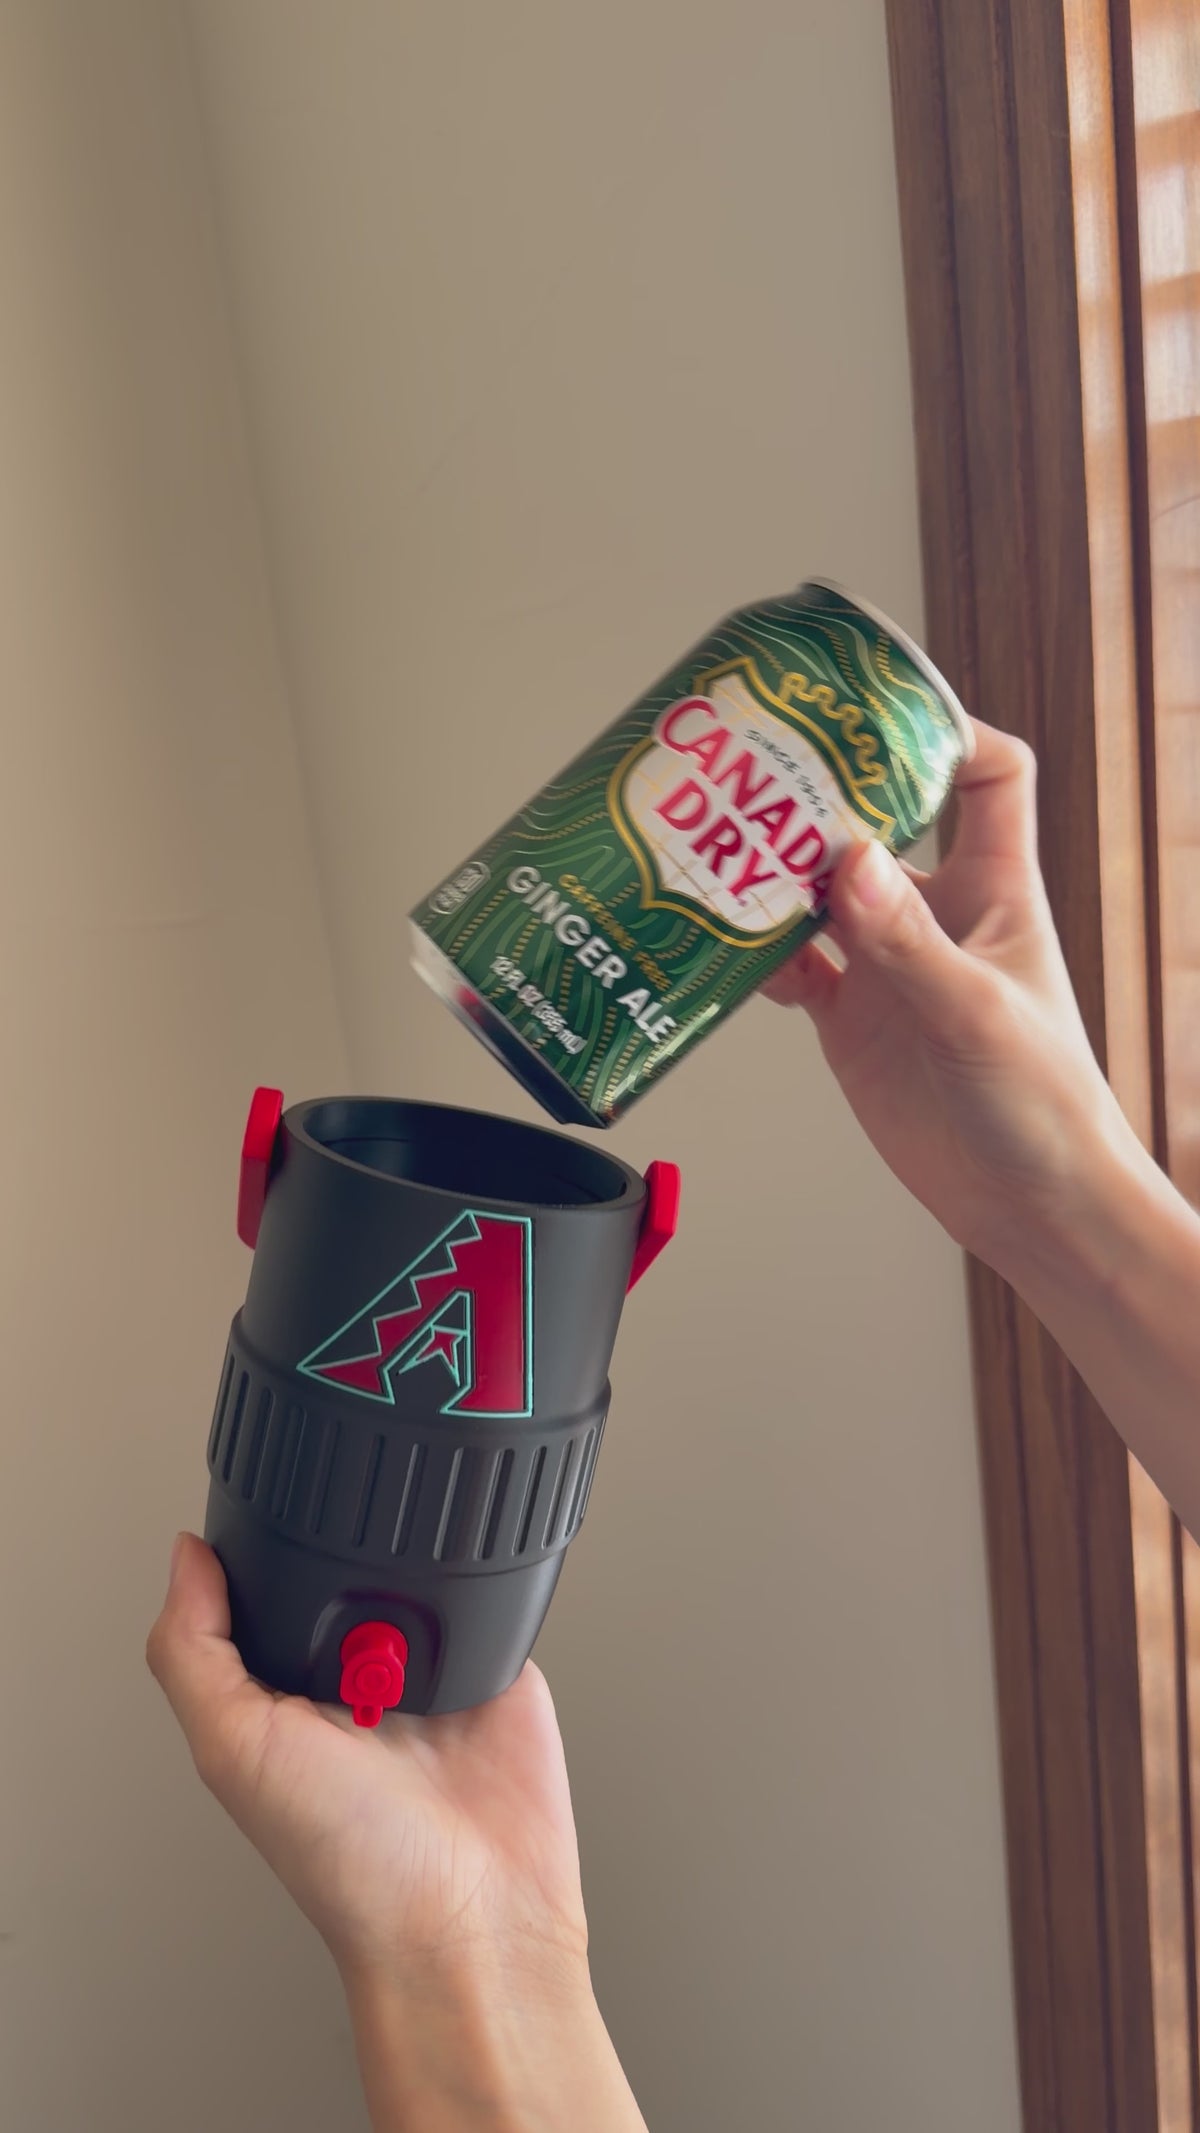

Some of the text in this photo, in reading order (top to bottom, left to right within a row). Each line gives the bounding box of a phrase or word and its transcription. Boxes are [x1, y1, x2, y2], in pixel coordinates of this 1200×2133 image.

[660, 699, 836, 908] CANADA
[743, 728, 802, 774] SINCE
[654, 777, 782, 896] DRY
[490, 956, 515, 977] 12
[506, 865, 678, 1043] GINGER ALE
[558, 873, 673, 992] CAFFEINE FREE
